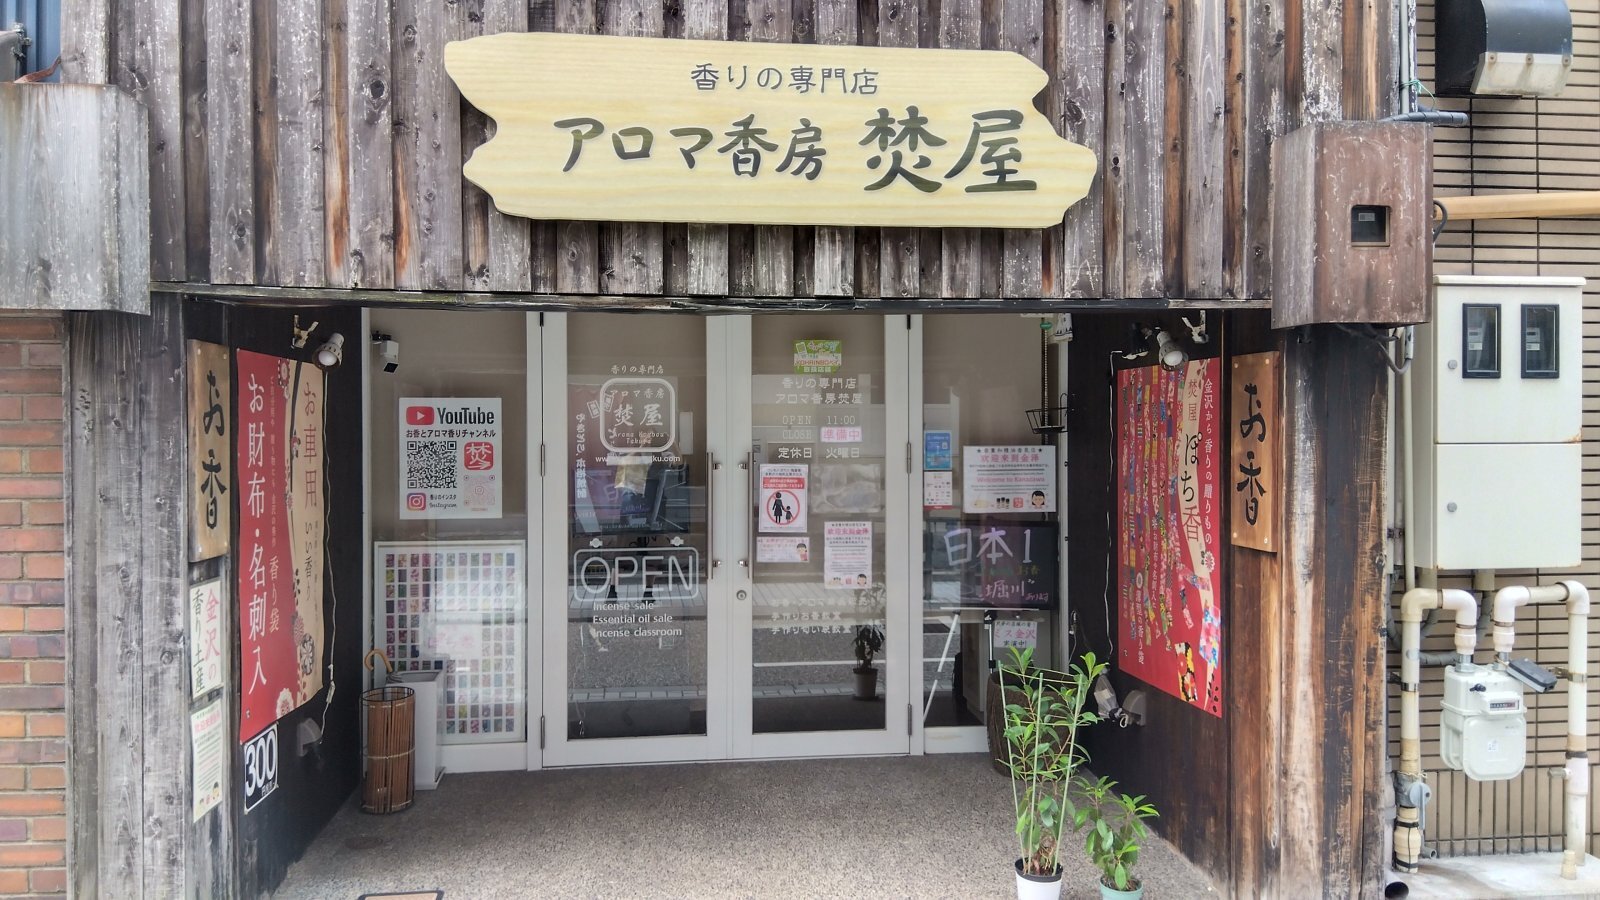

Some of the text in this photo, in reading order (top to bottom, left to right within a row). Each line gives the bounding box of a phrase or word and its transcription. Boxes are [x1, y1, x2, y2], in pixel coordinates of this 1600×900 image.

[691, 62, 880, 94] 香りの専門店
[552, 105, 1038, 194] アロマ香房 焚屋
[610, 364, 665, 375] 香りの専門店
[781, 377, 857, 389] 香りの専門店
[609, 387, 665, 399] アロマ香房
[775, 392, 864, 405] アロマ香房焚屋
[1187, 379, 1198, 421] 焚屋
[437, 407, 495, 425] YouTube
[613, 403, 664, 427] 焚屋
[782, 415, 856, 425] OPEN 11:00
[406, 429, 497, 439] お香とアロマ香りチャンネル
[782, 429, 812, 439] CLOSE
[823, 428, 860, 441] 準備中
[200, 370, 228, 529] お香
[303, 382, 318, 511] お車用
[778, 447, 860, 459] 定休日 火曜日
[1203, 378, 1214, 543] 金沢から香りの贈りもの
[1236, 382, 1267, 526] お香
[580, 555, 693, 594] OPEN
[593, 601, 655, 611] Incense sale
[593, 613, 673, 624] Essential oil sale
[204, 587, 220, 681] 金沢の
[593, 626, 682, 638] Incense classroom
[771, 624, 852, 635] 手作り匂い袋教室
[995, 628, 1036, 639] ミス金沢
[245, 730, 277, 798] 300
